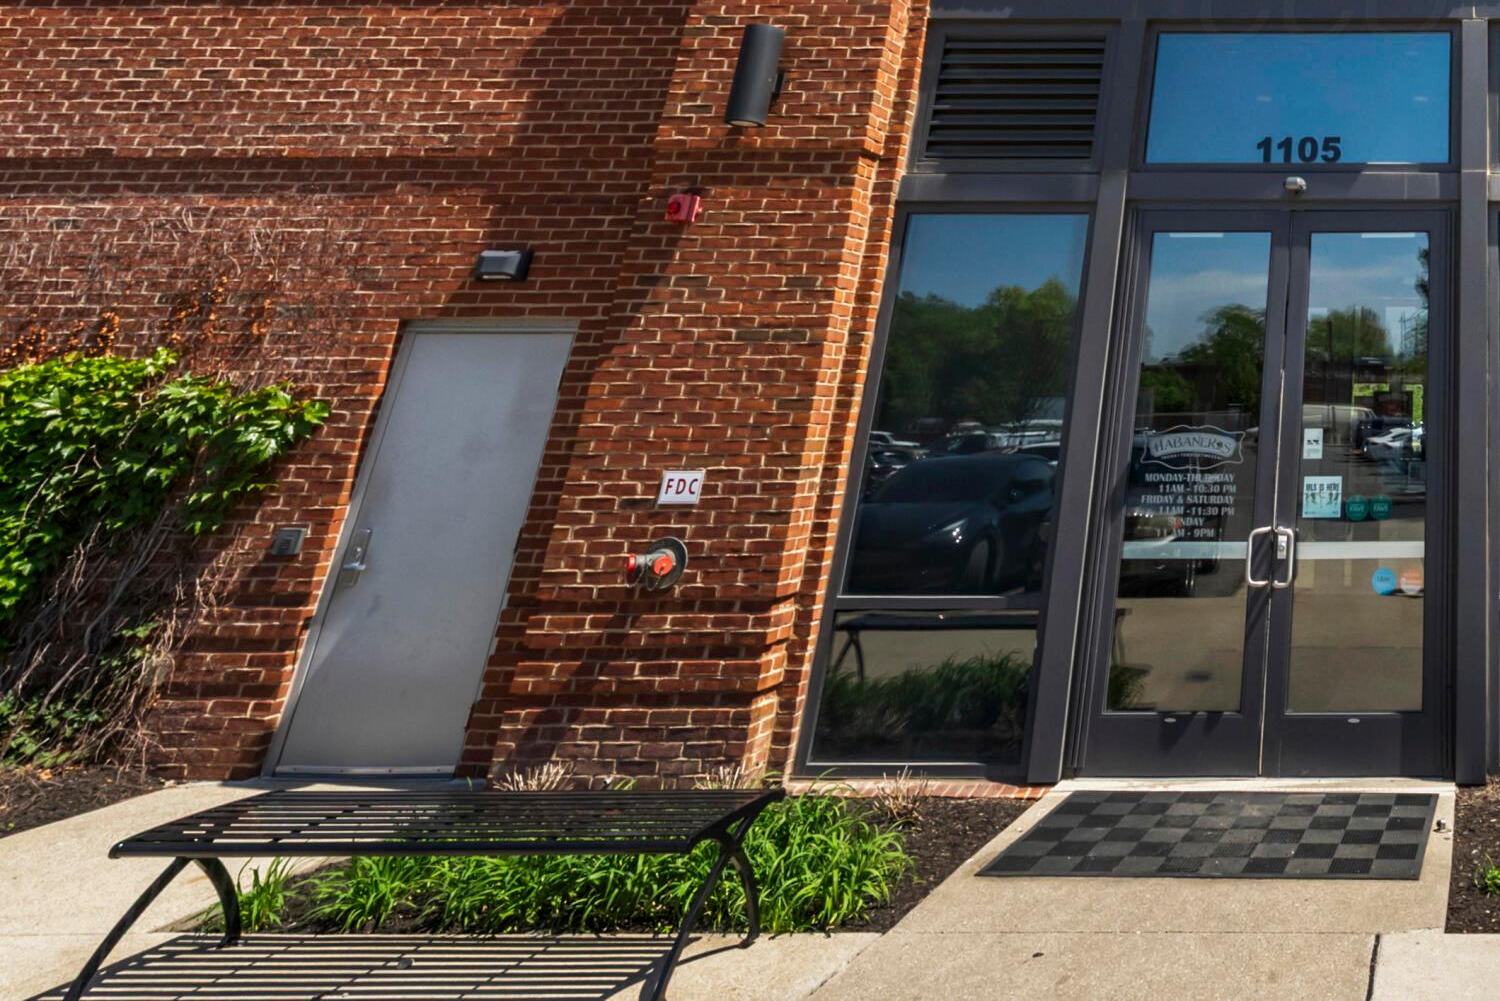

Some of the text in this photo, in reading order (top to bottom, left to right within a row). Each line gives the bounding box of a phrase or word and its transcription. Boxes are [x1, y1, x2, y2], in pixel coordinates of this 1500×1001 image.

[1256, 136, 1342, 163] 1105
[664, 478, 699, 495] FDC
[1159, 484, 1185, 493] 11AM
[1193, 484, 1220, 493] 10:30
[1222, 484, 1237, 493] PM
[1141, 495, 1235, 504] FRIDAY & SATURDAY
[1221, 506, 1235, 515] PM
[1193, 528, 1215, 537] 9PM
